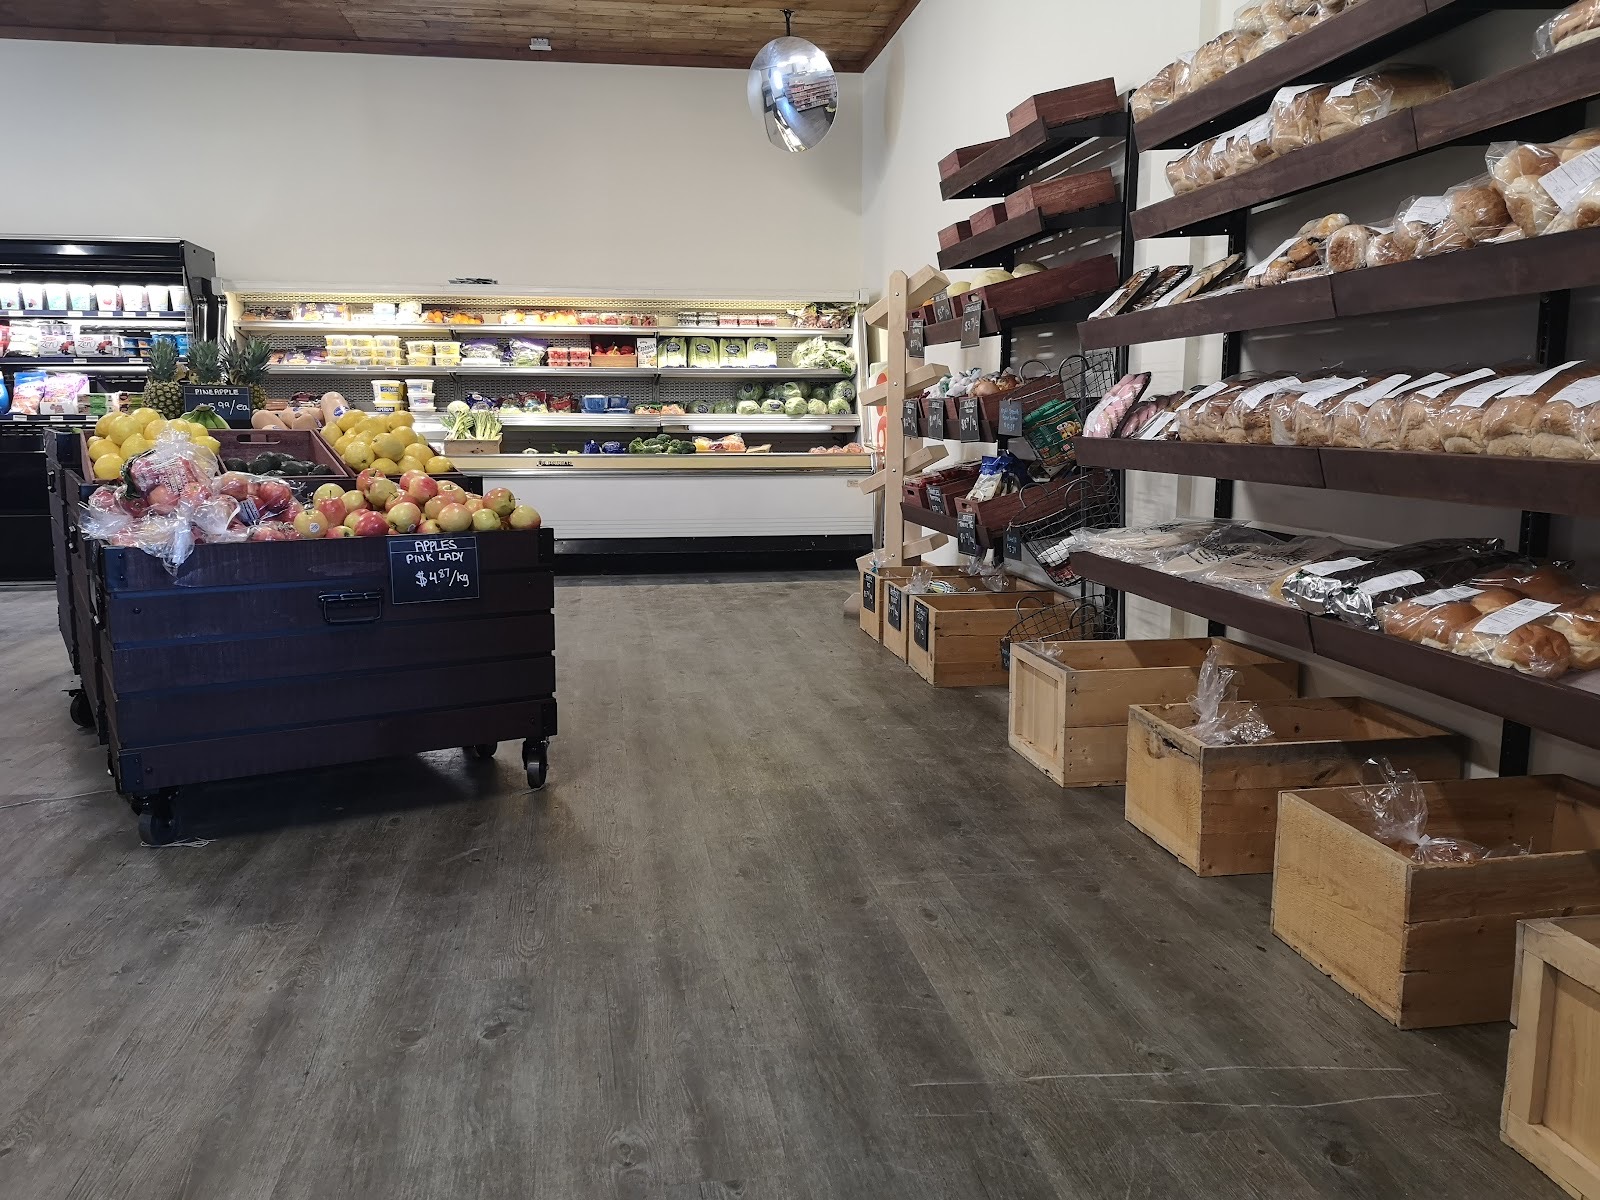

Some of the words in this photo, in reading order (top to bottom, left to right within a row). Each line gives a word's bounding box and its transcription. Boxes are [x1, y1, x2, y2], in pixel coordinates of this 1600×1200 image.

[194, 388, 240, 396] PINEAPPLE
[414, 539, 458, 553] APPLES
[405, 553, 435, 565] PINK
[438, 551, 464, 562] LADY
